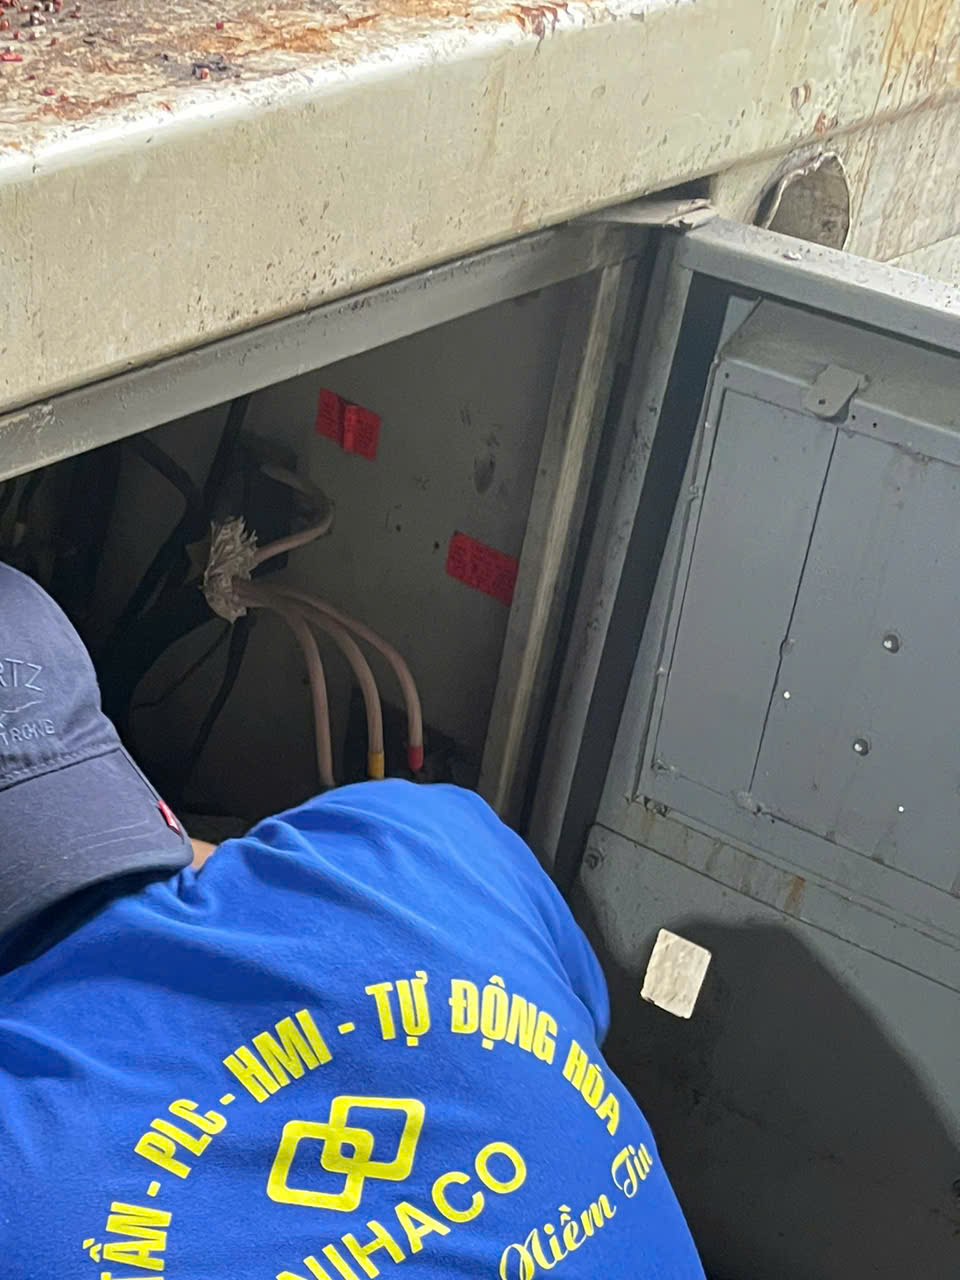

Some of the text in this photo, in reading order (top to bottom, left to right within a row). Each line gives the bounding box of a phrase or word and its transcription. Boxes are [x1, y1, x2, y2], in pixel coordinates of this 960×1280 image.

[131, 1098, 227, 1182] PLC
[222, 1008, 333, 1104] HMI
[364, 970, 431, 1047] TỰ
[447, 974, 559, 1065] ĐỘNG
